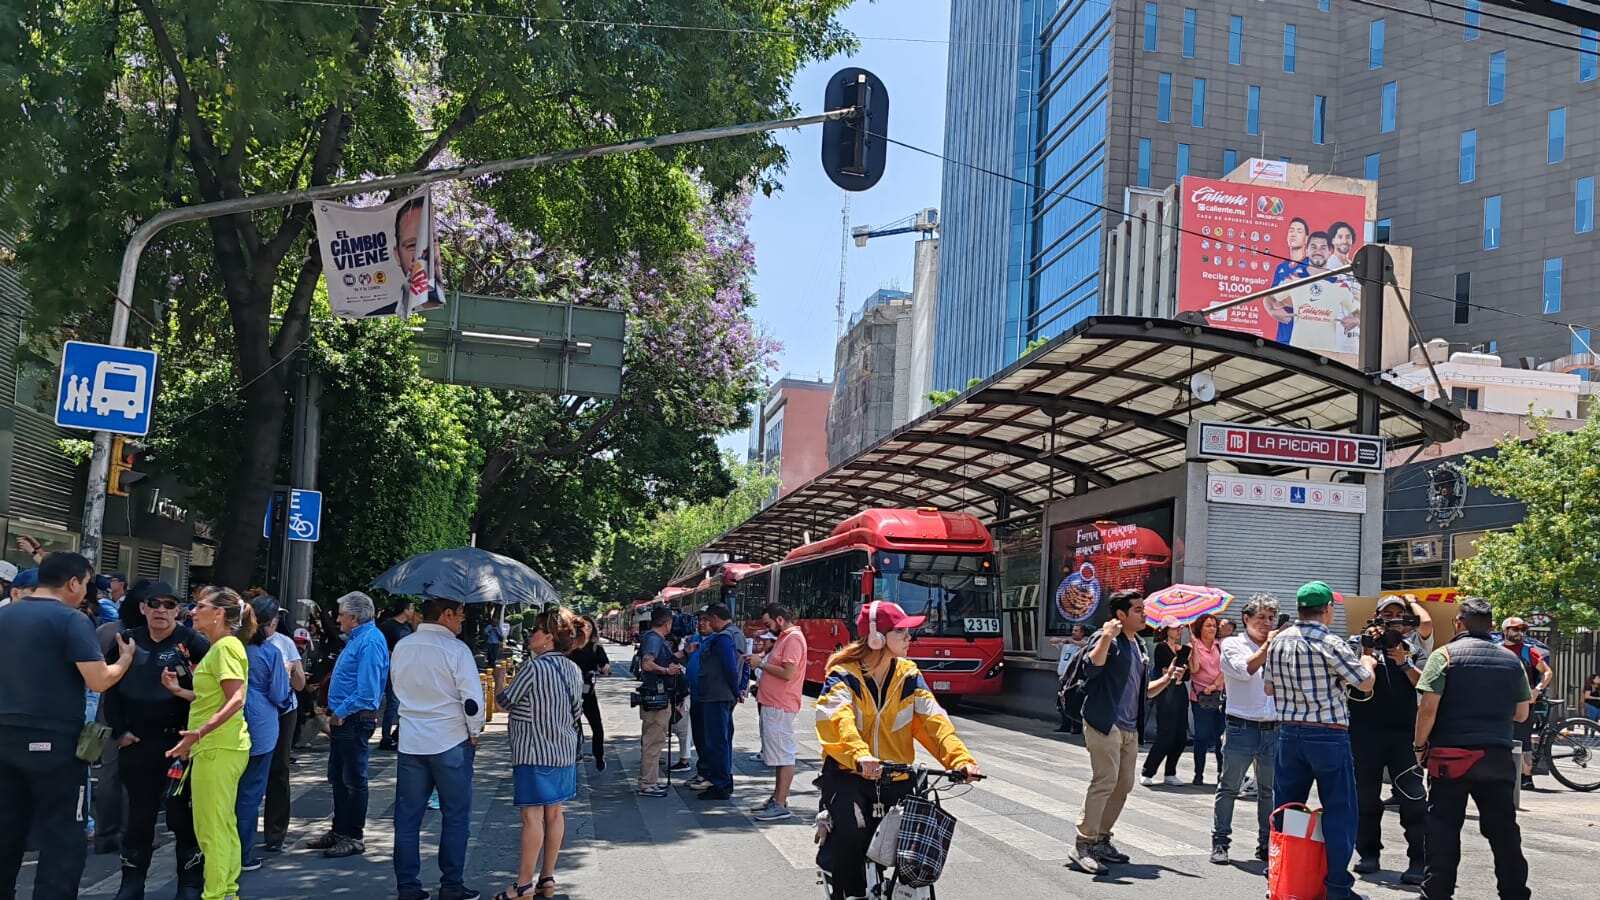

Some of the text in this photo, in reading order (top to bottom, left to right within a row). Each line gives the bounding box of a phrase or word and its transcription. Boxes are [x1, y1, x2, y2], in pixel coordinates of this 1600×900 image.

[1191, 186, 1248, 206] Caliente
[336, 230, 349, 239] EL
[330, 231, 387, 257] CAMBIO
[334, 247, 390, 270] VIENE
[1202, 271, 1229, 280] Recibe
[1230, 274, 1240, 282] de
[1218, 281, 1252, 294] $1,000
[1256, 436, 1329, 454] LA PIEDAD
[1343, 444, 1349, 459] 1
[967, 618, 998, 632] 2319
